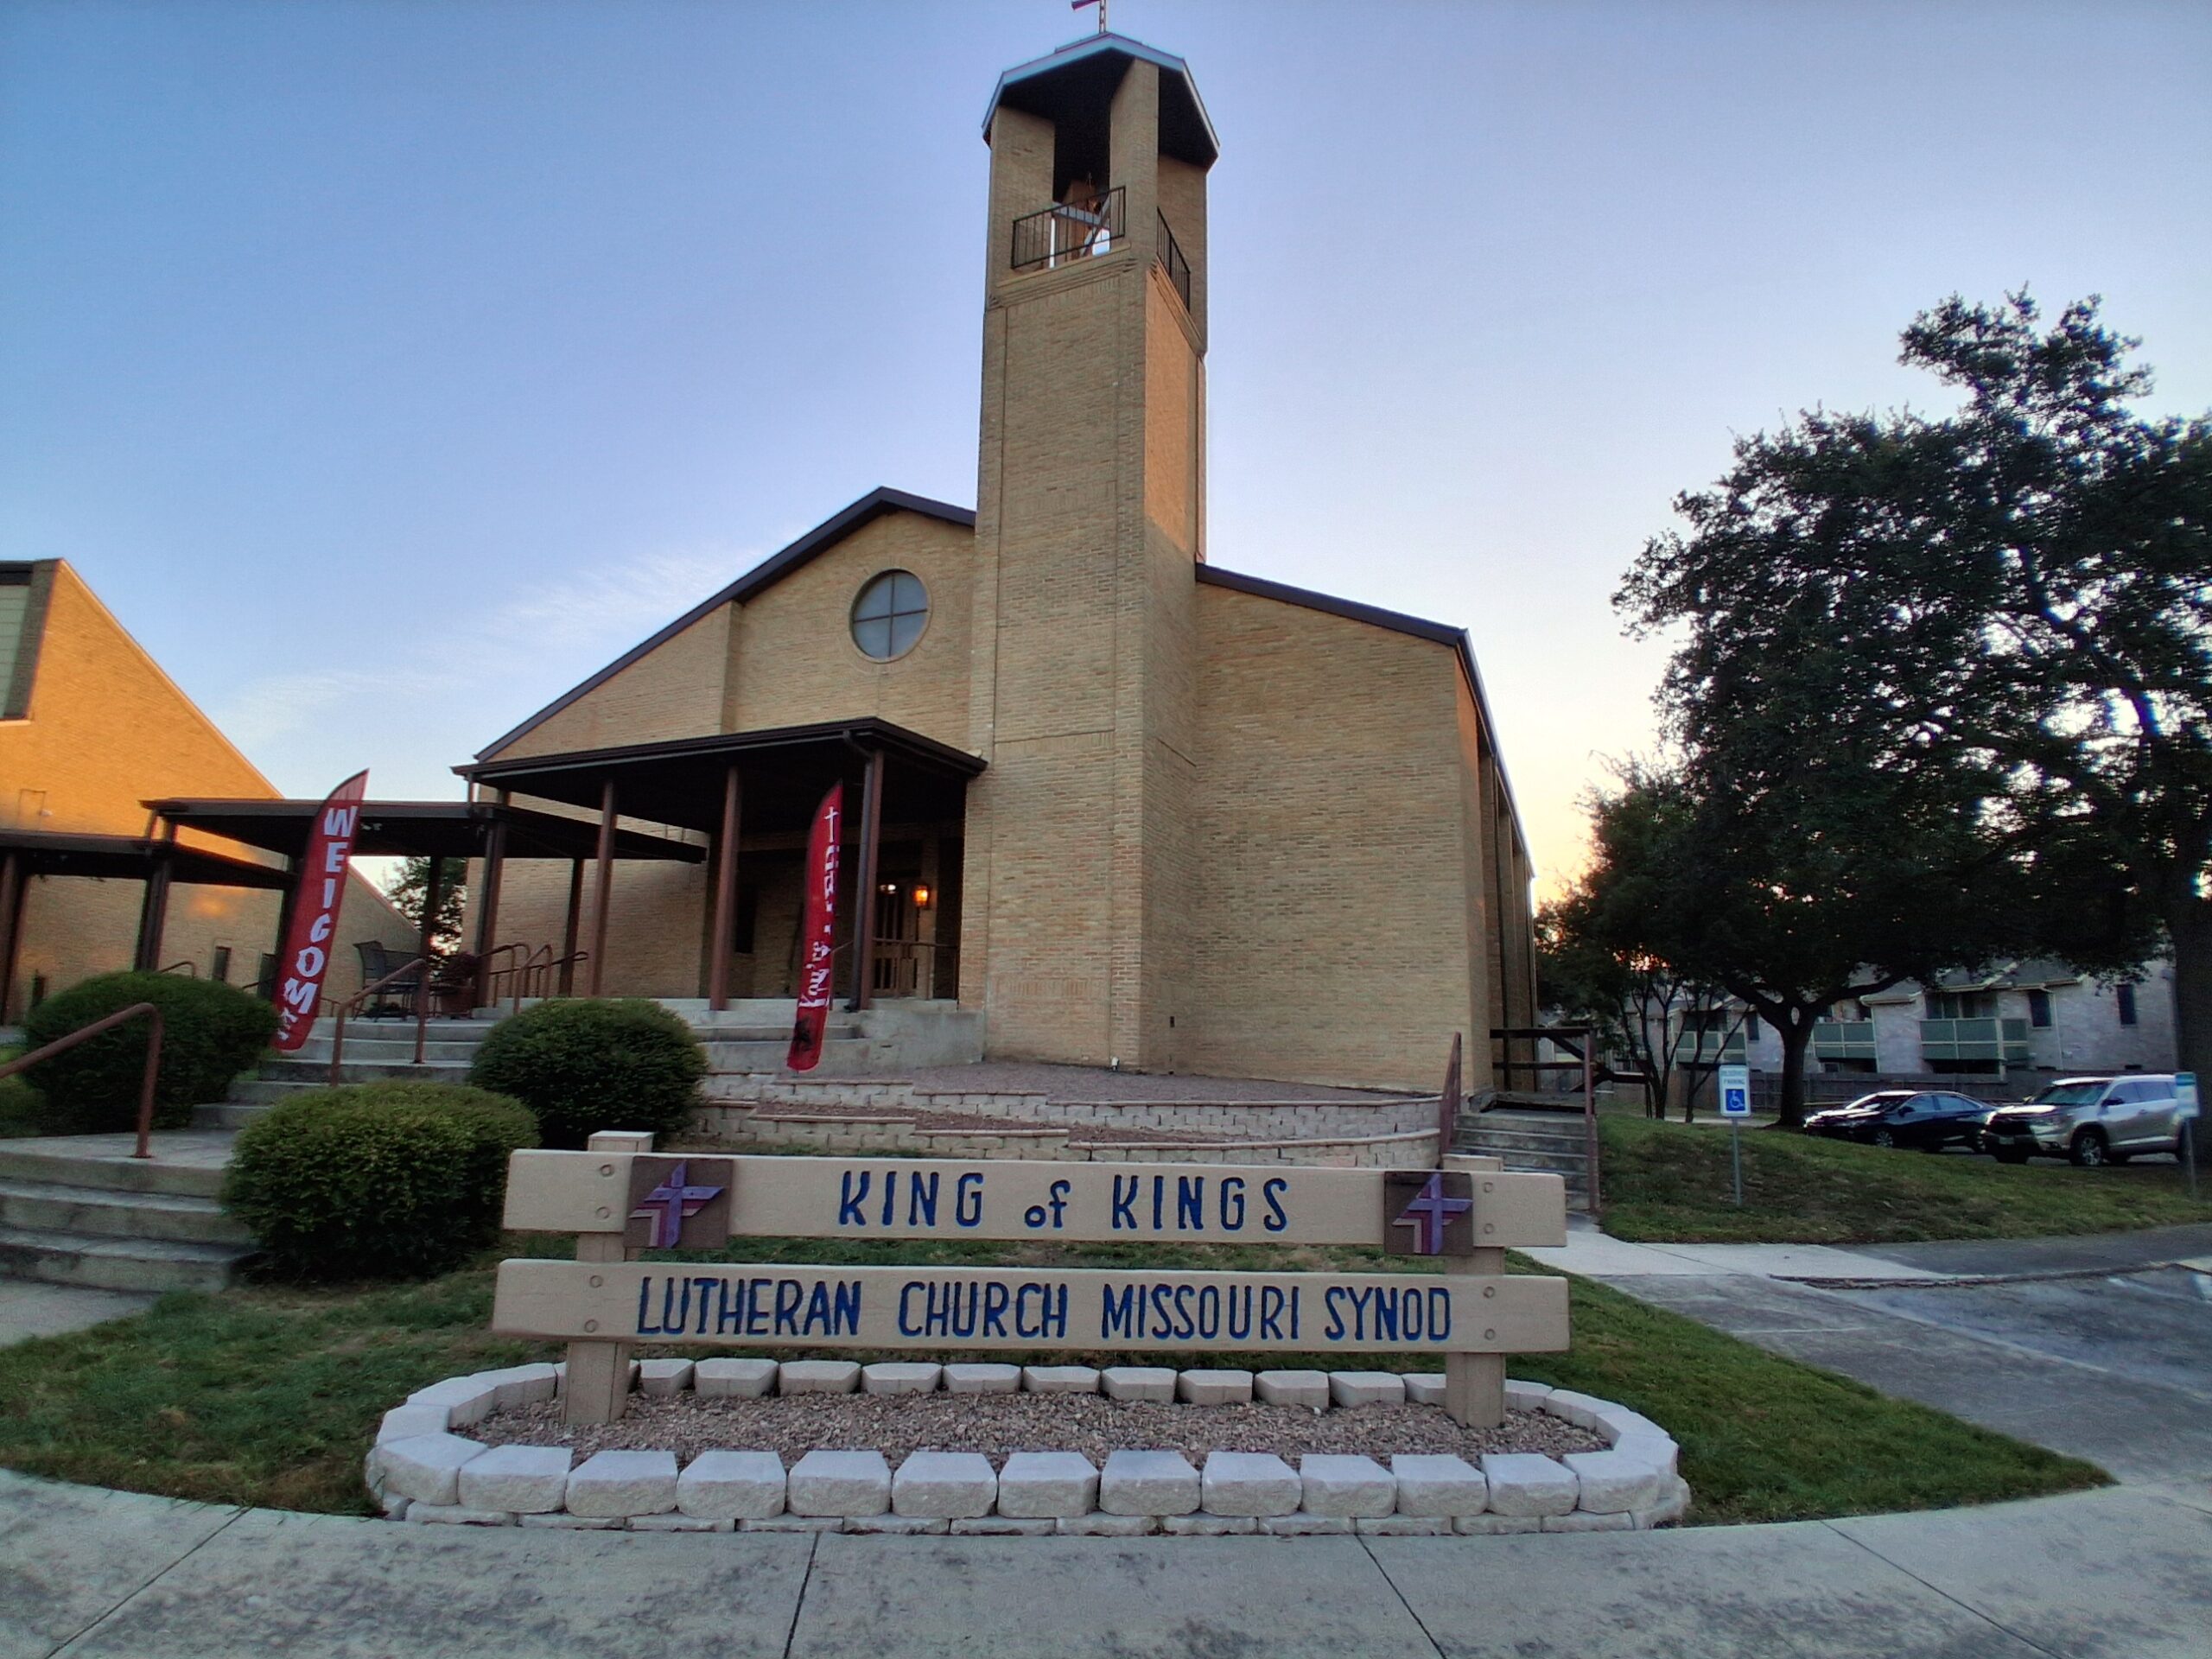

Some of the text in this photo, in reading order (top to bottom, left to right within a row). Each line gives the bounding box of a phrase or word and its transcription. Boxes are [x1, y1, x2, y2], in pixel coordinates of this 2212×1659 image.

[837, 1170, 1290, 1233] KING of KINGS
[636, 1275, 1452, 1343] LUTHERAN CHURCH MISSOURI SYNOD
